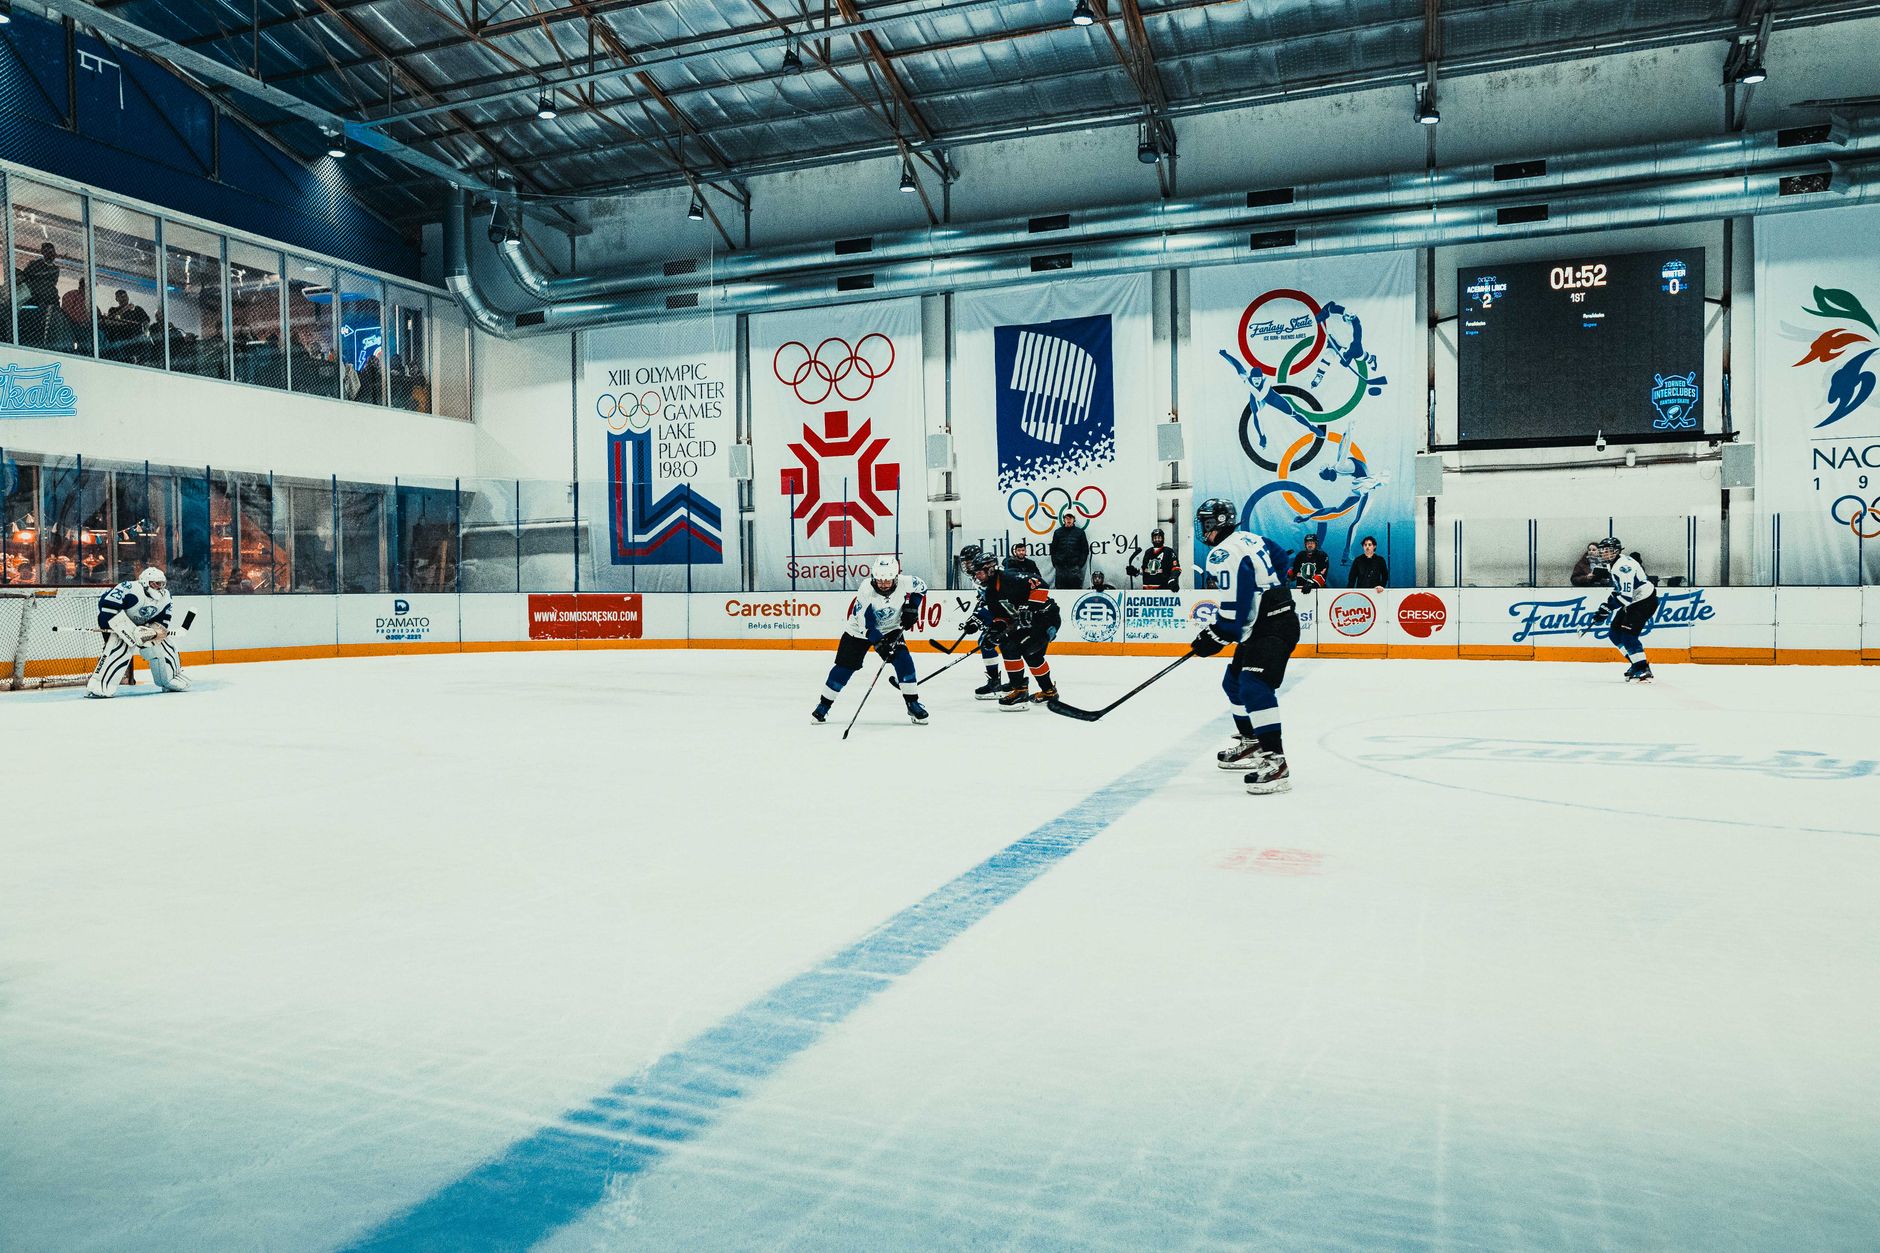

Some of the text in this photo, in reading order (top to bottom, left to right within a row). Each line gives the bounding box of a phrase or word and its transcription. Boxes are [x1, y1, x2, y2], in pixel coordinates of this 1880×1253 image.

[1550, 264, 1607, 289] 01:52
[1669, 279, 1679, 294] 0
[1483, 293, 1492, 308] 2
[1570, 293, 1586, 302] 1ST
[1249, 314, 1312, 338] Fantasy Skate
[608, 363, 707, 386] XIII OLYMPIC
[0, 362, 78, 409] kate
[661, 382, 725, 402] WINTER
[1654, 387, 1696, 400] INTERCLUBES
[663, 401, 721, 421] GAMES
[659, 422, 695, 441] LAKE
[659, 440, 717, 459] PLACID
[659, 460, 698, 479] 1980
[1813, 475, 1868, 491] 1 9
[786, 561, 871, 582] Sarajevo
[1624, 583, 1631, 592] 16
[725, 599, 822, 617] Carestino
[1126, 597, 1181, 607] ACADEMIA
[533, 611, 638, 622] WWW.SOMOSCRESKO.COM
[1126, 608, 1174, 617] DE ARTES
[1334, 606, 1371, 619] Funny
[1399, 610, 1446, 620] CRESKO
